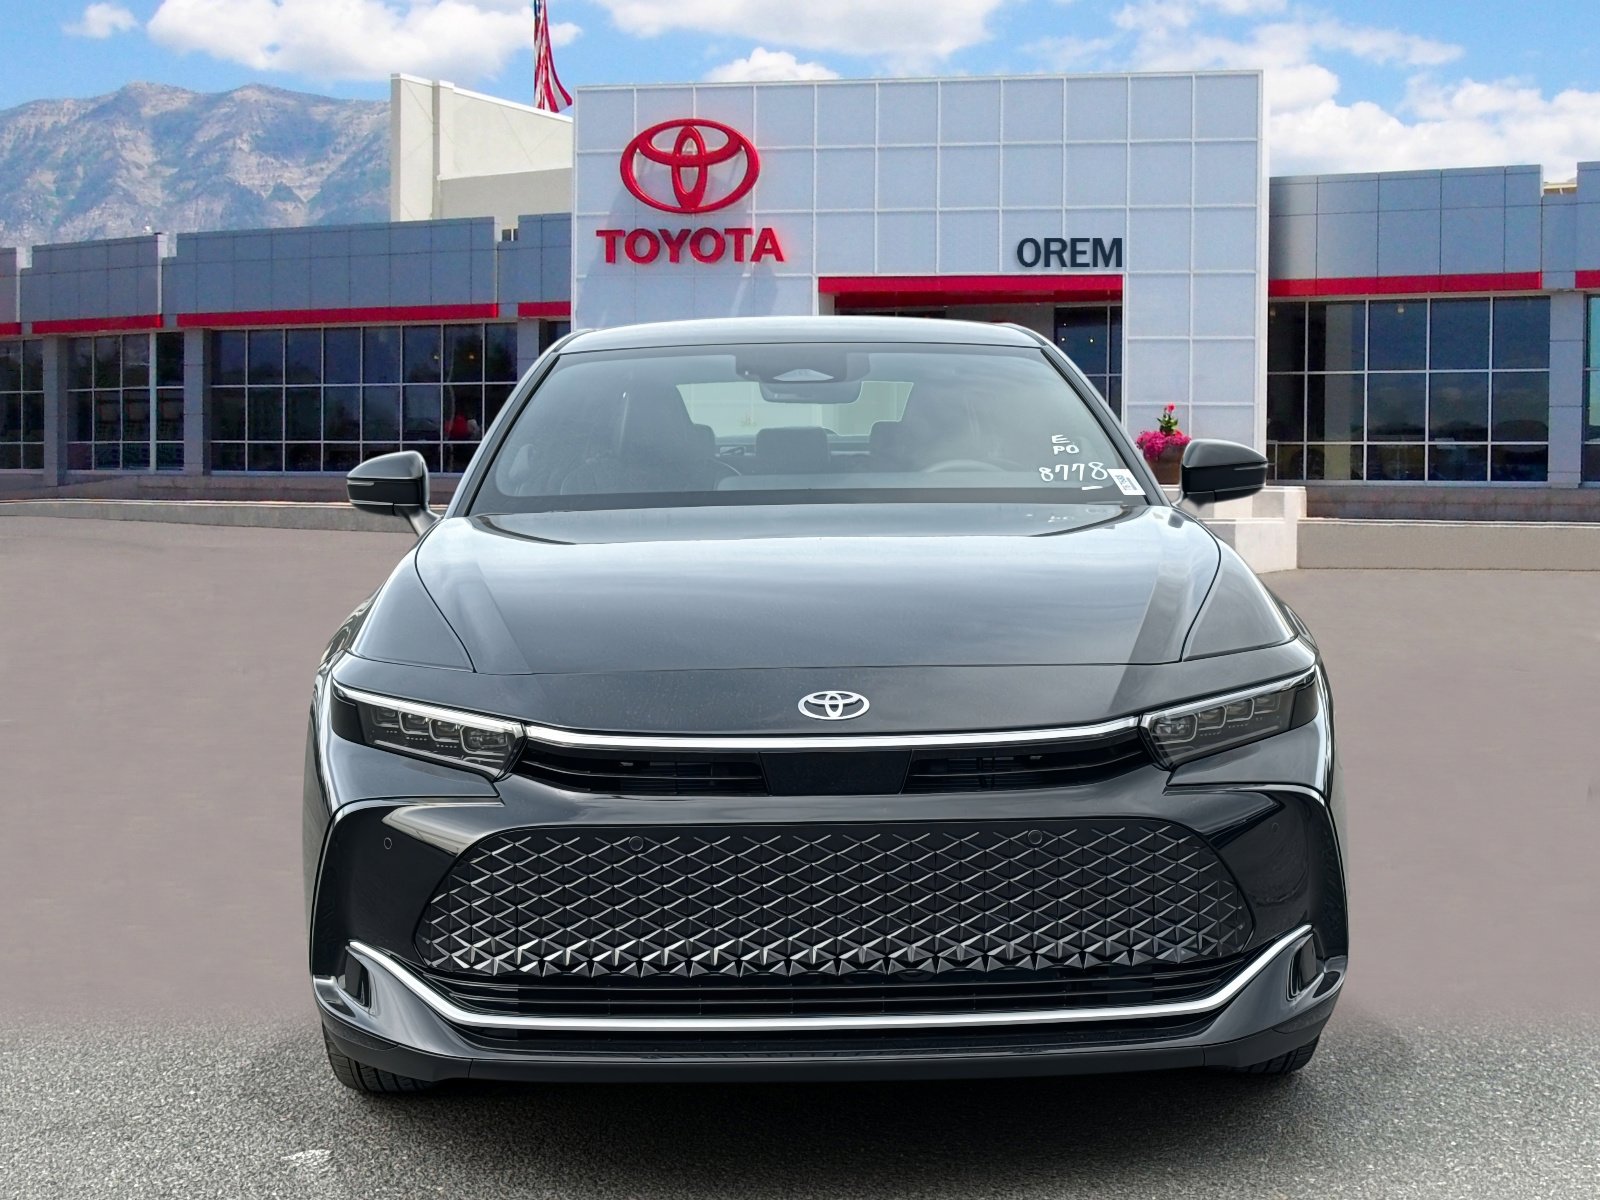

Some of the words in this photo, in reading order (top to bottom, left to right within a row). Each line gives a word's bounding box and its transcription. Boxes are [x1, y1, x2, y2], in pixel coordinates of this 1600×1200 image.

[596, 227, 784, 264] TOYOTA
[1017, 237, 1122, 268] OREM
[1038, 461, 1108, 482] 8778
